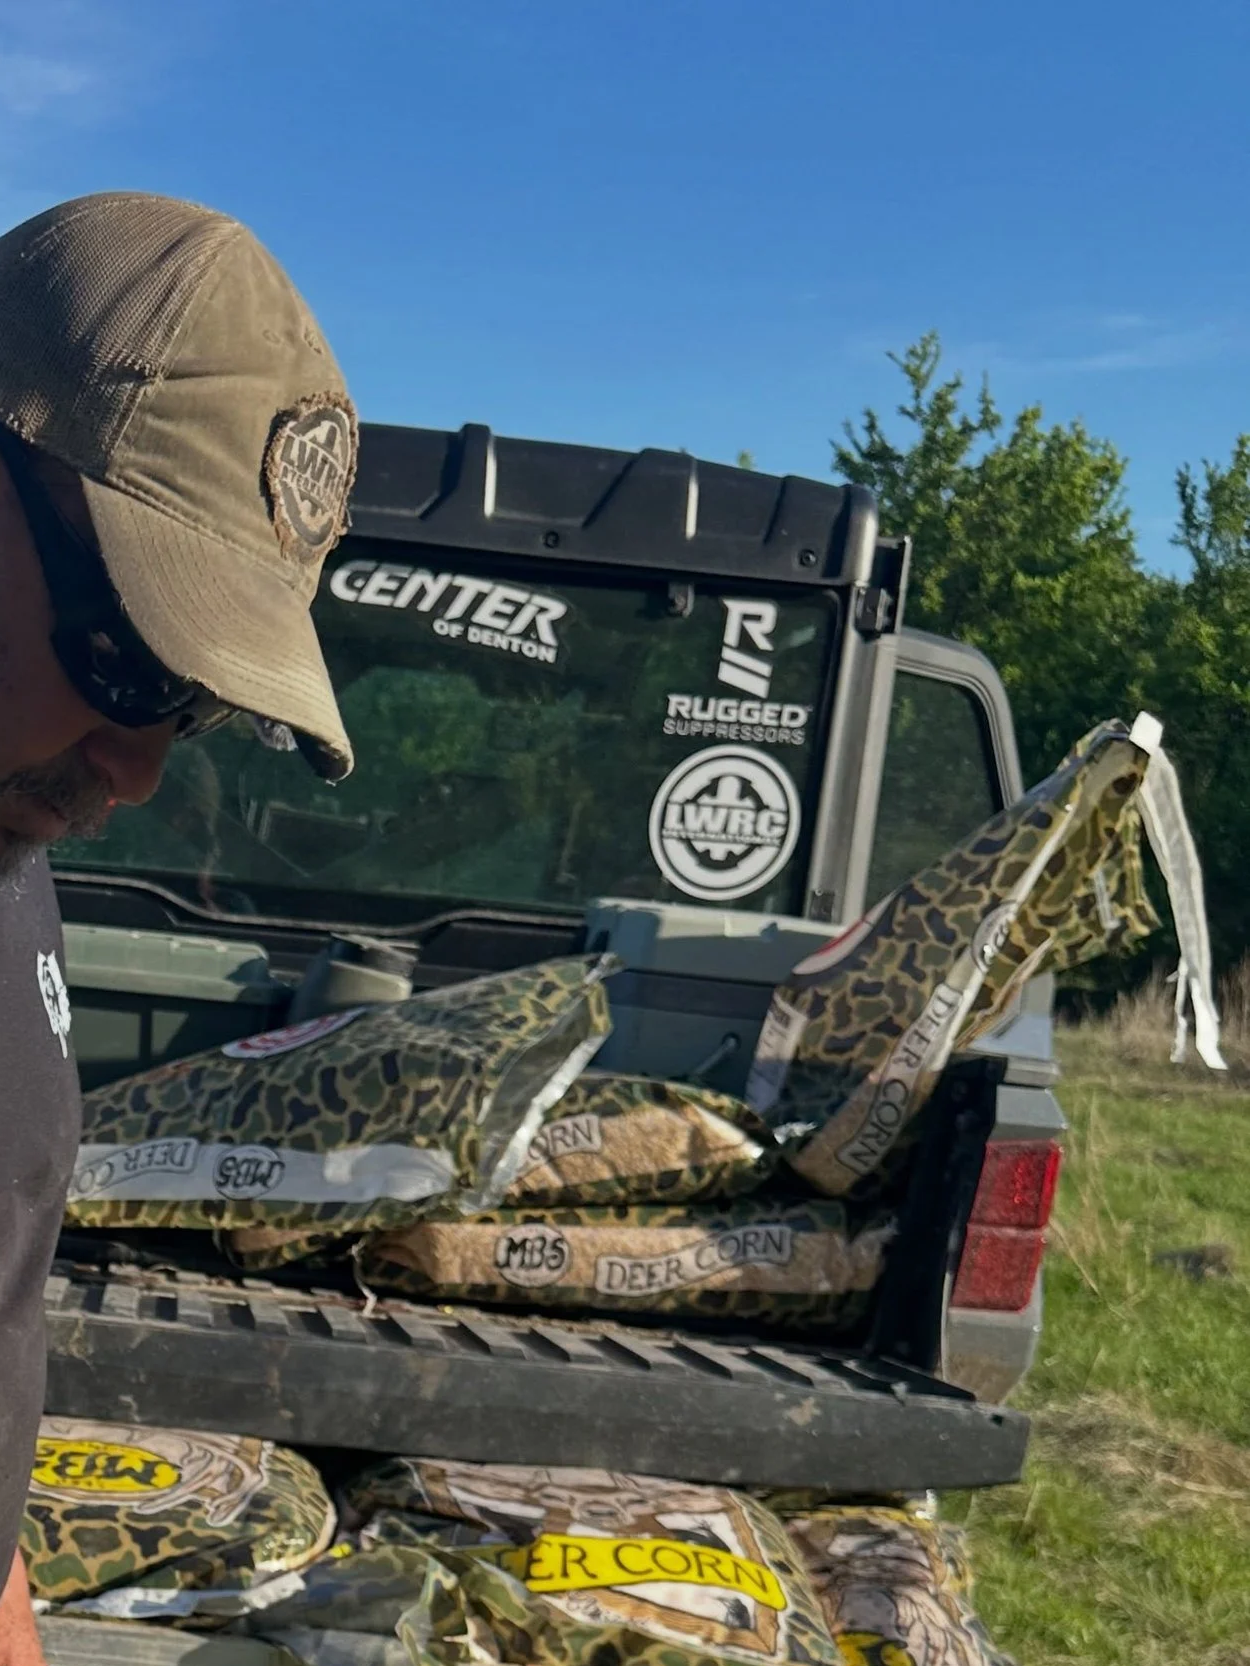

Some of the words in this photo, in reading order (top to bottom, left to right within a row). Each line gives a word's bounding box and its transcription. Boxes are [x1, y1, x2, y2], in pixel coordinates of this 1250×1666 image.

[329, 559, 567, 648] CENTER
[432, 618, 464, 639] OF
[467, 624, 558, 665] DENTON
[662, 717, 806, 746] SUPPRESSORS
[666, 693, 808, 729] RUGGED
[662, 801, 788, 838] LWRC
[893, 993, 961, 1070] DEER
[527, 1117, 593, 1162] ORN
[847, 1078, 910, 1176] CORN
[71, 1160, 114, 1194] CO
[122, 1140, 191, 1172] DEER
[605, 1256, 686, 1292] DEER
[693, 1230, 786, 1272] CORN
[612, 1541, 770, 1594] CORN
